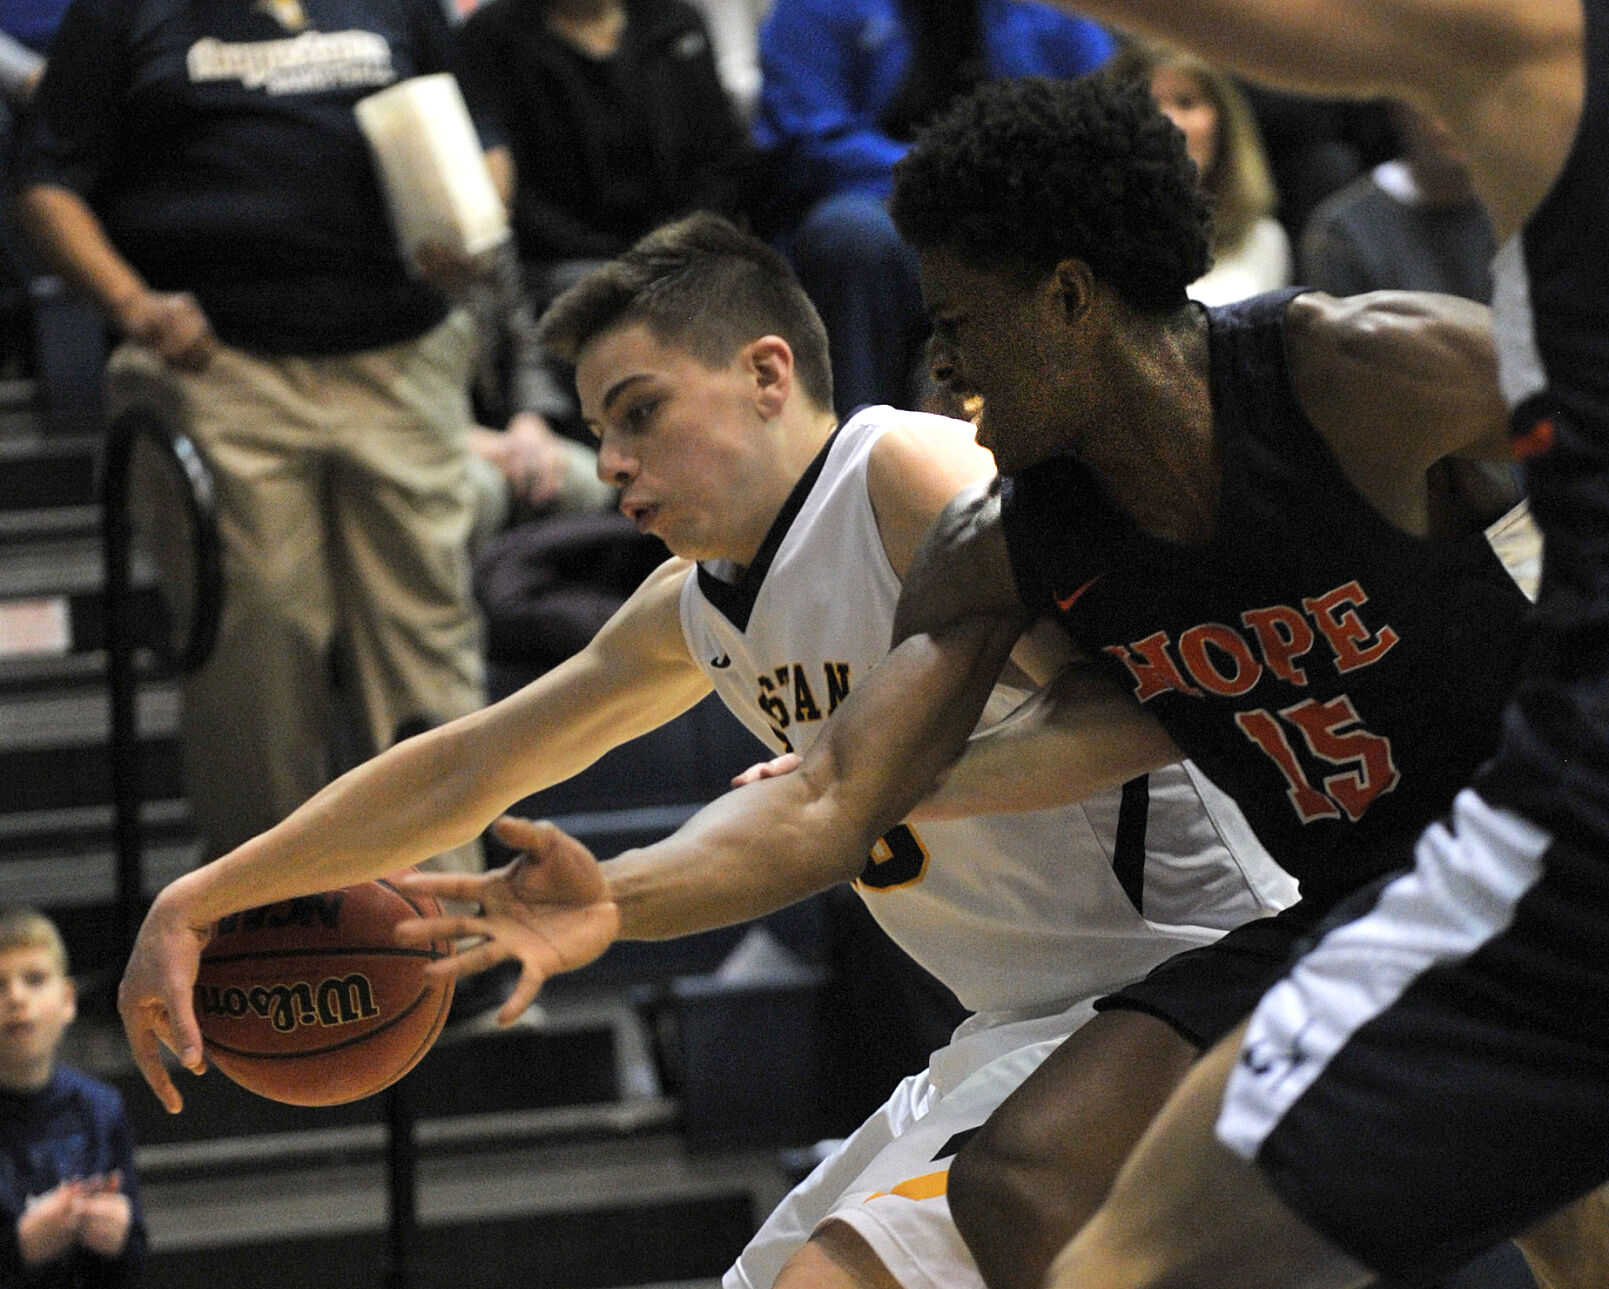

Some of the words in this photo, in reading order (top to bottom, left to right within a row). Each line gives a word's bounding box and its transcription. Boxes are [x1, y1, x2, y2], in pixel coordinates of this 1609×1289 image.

[1102, 579, 1400, 704] HOPE
[1234, 693, 1401, 825] 15
[195, 972, 380, 1034] Wilson
